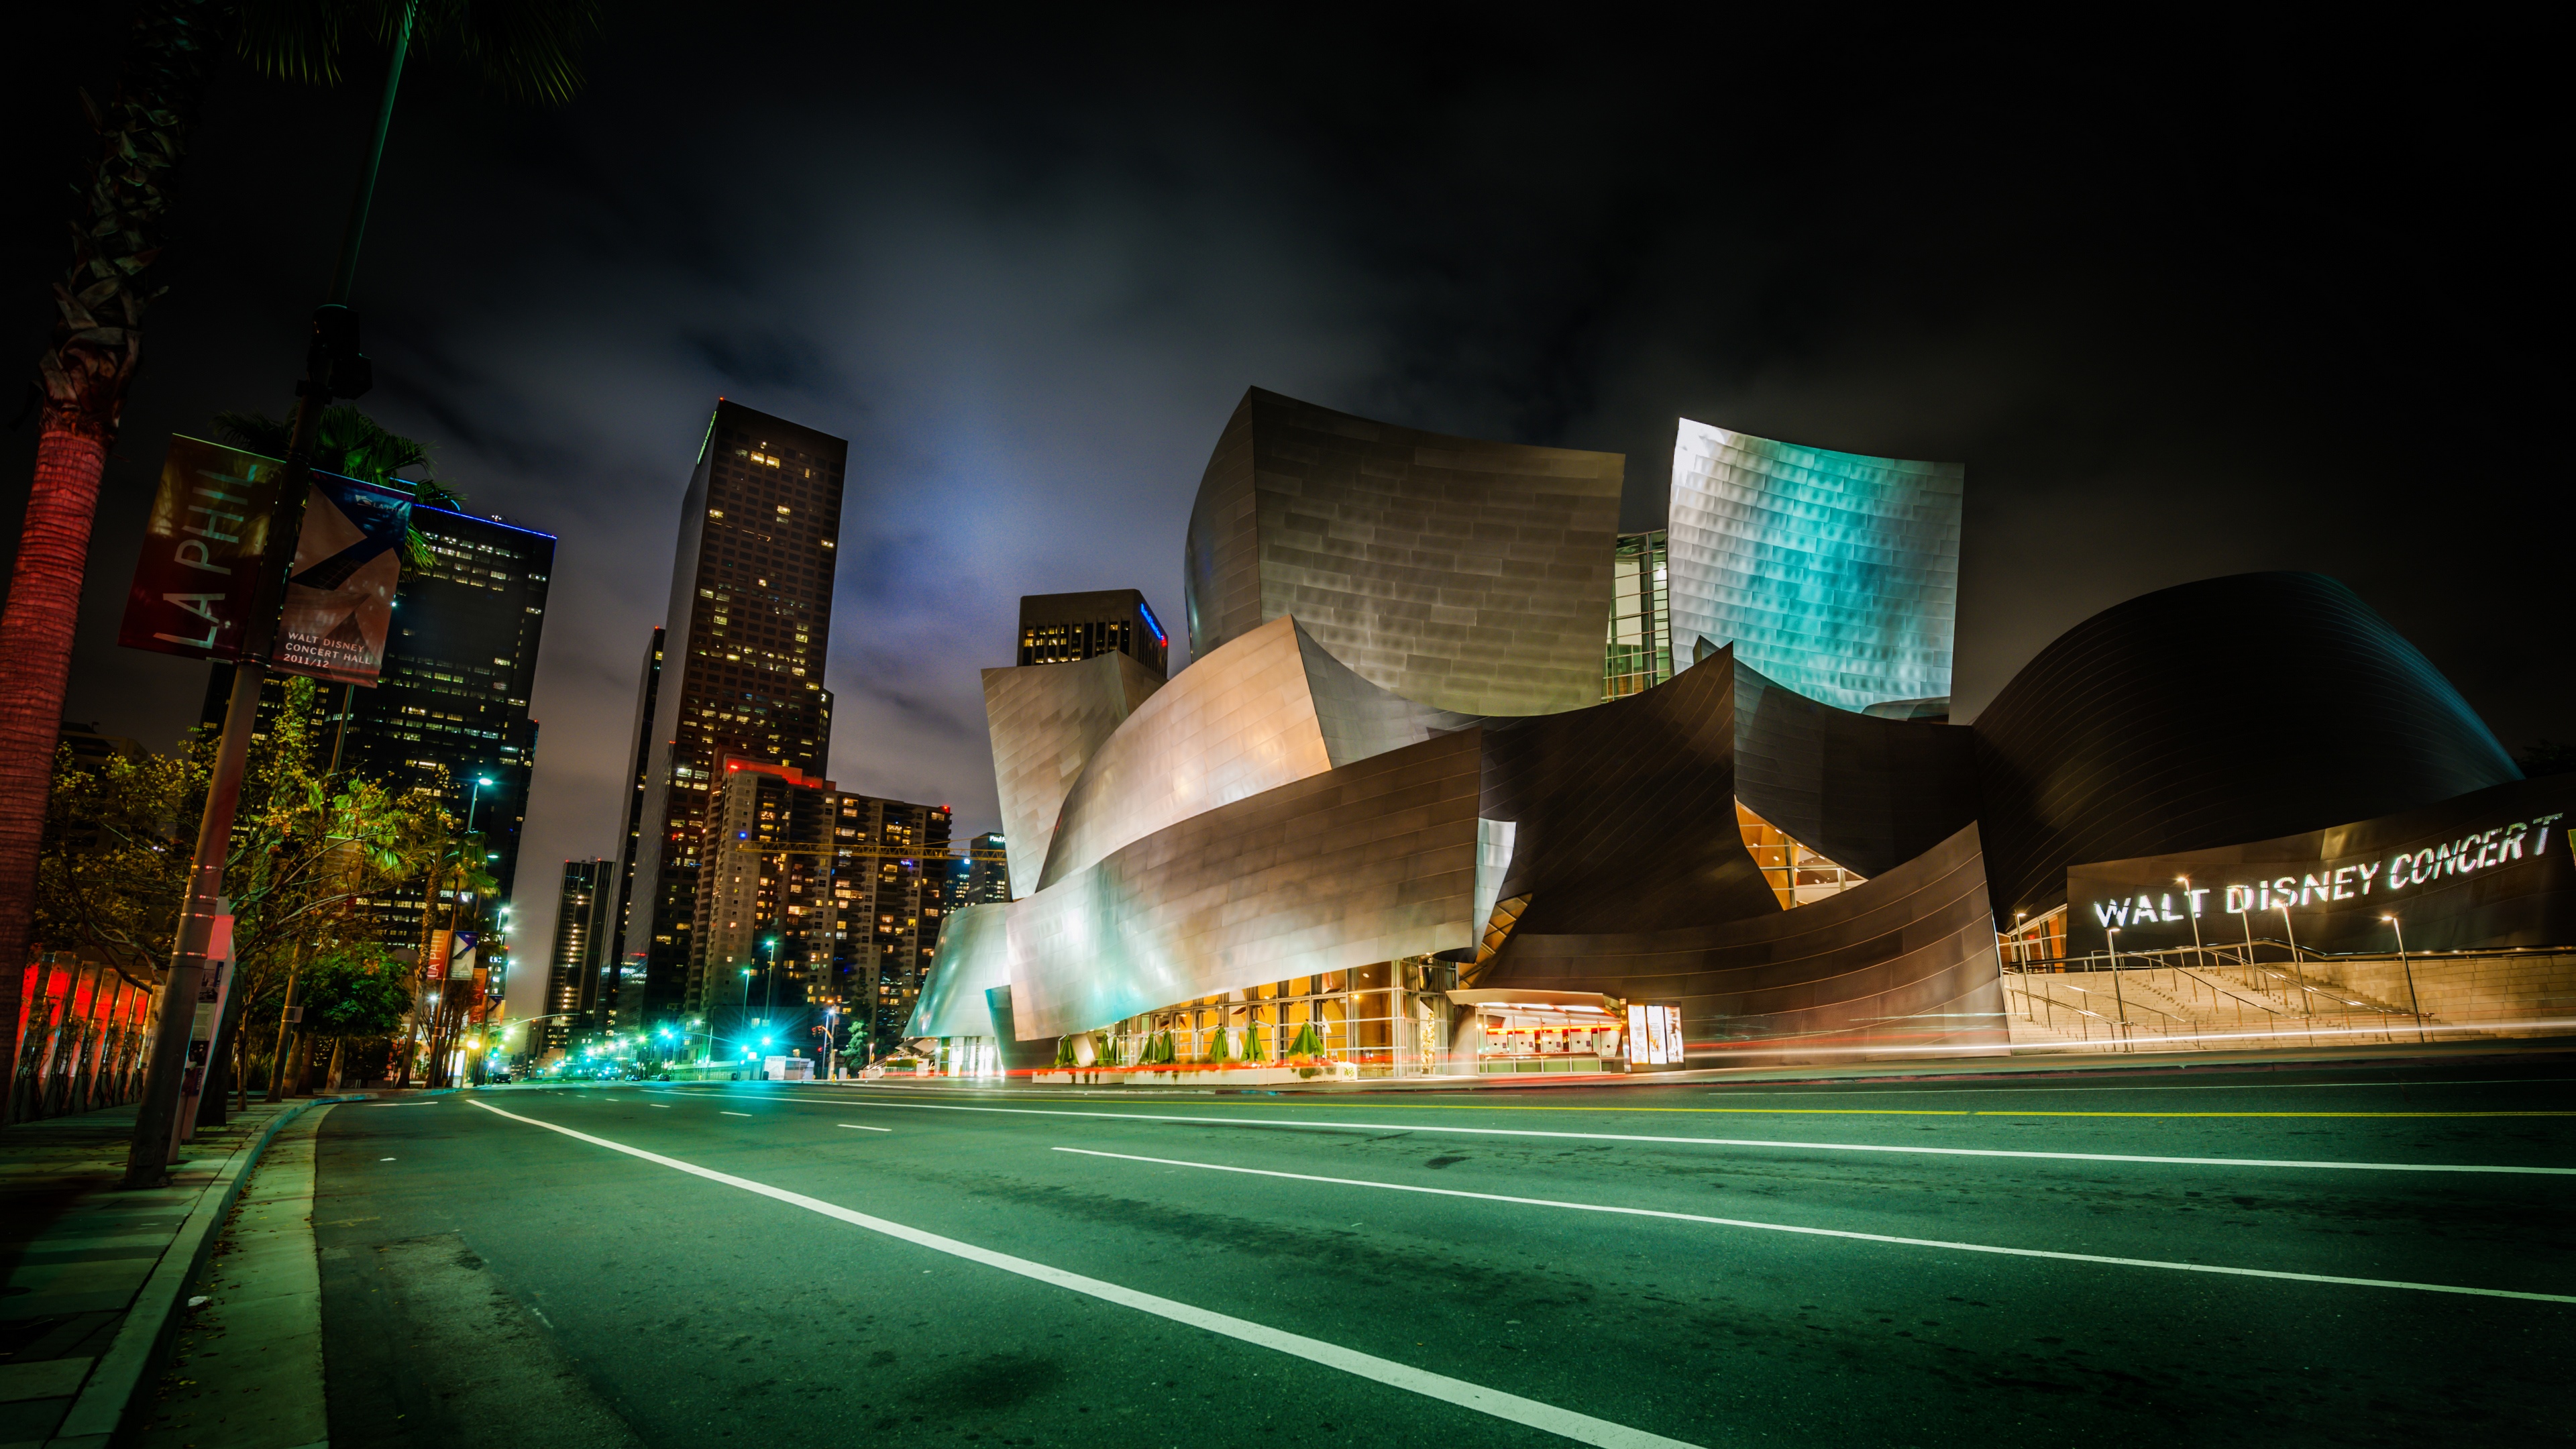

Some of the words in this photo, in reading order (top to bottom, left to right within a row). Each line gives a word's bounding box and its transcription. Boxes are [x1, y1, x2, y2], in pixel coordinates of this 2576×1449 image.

[373, 502, 384, 510] LA
[174, 464, 257, 576] PHIL
[153, 593, 226, 650] LA
[288, 631, 319, 644] WALT
[323, 639, 365, 653] DISNEY
[283, 653, 329, 668] 2011/12
[285, 643, 339, 659] CONCERT
[343, 653, 370, 665] HALL
[2093, 888, 2211, 928] WALT
[2226, 861, 2381, 914] DISNEY
[2390, 812, 2564, 890] CONCERT
[427, 963, 440, 977] LA
